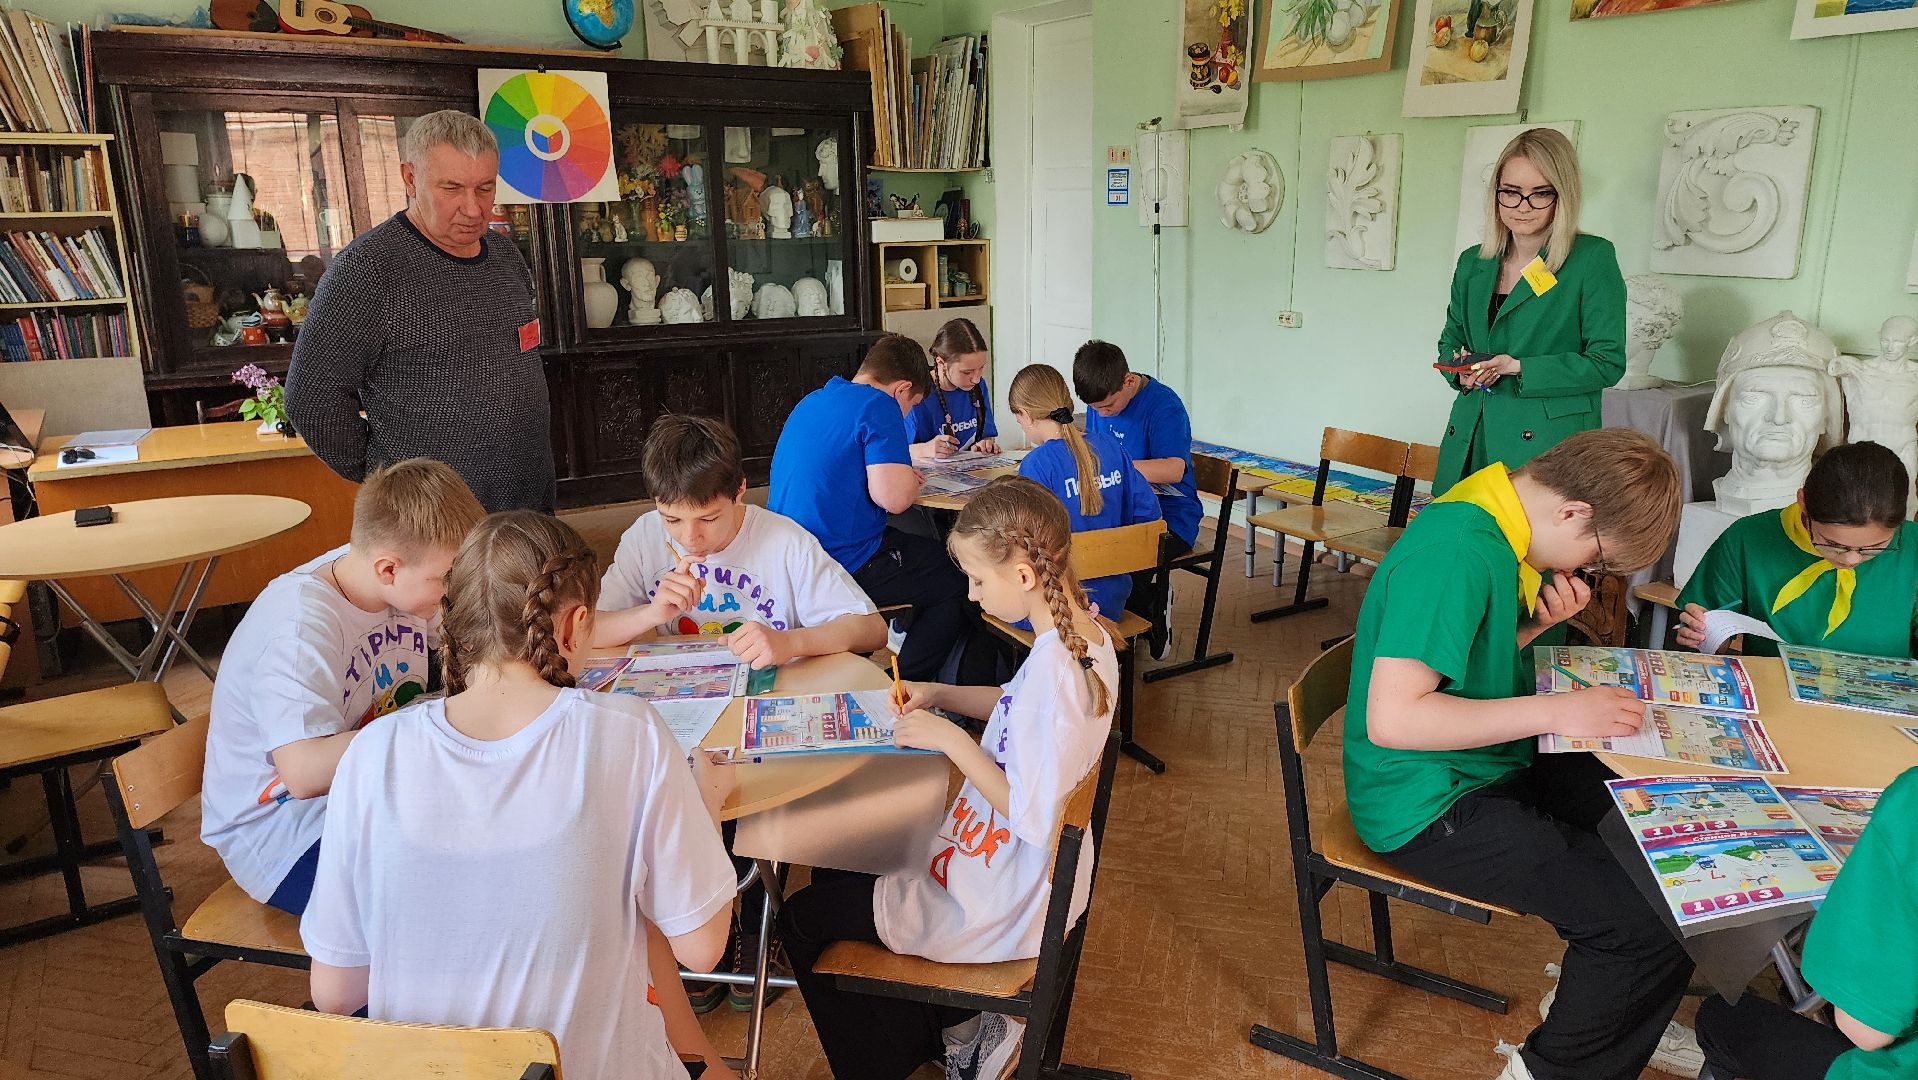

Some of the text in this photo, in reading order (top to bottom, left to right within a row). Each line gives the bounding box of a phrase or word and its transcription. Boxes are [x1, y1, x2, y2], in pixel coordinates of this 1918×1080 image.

[942, 418, 977, 435] Првые
[1653, 820, 1728, 836] 1 2 3
[1694, 889, 1774, 912] 1 2 3
